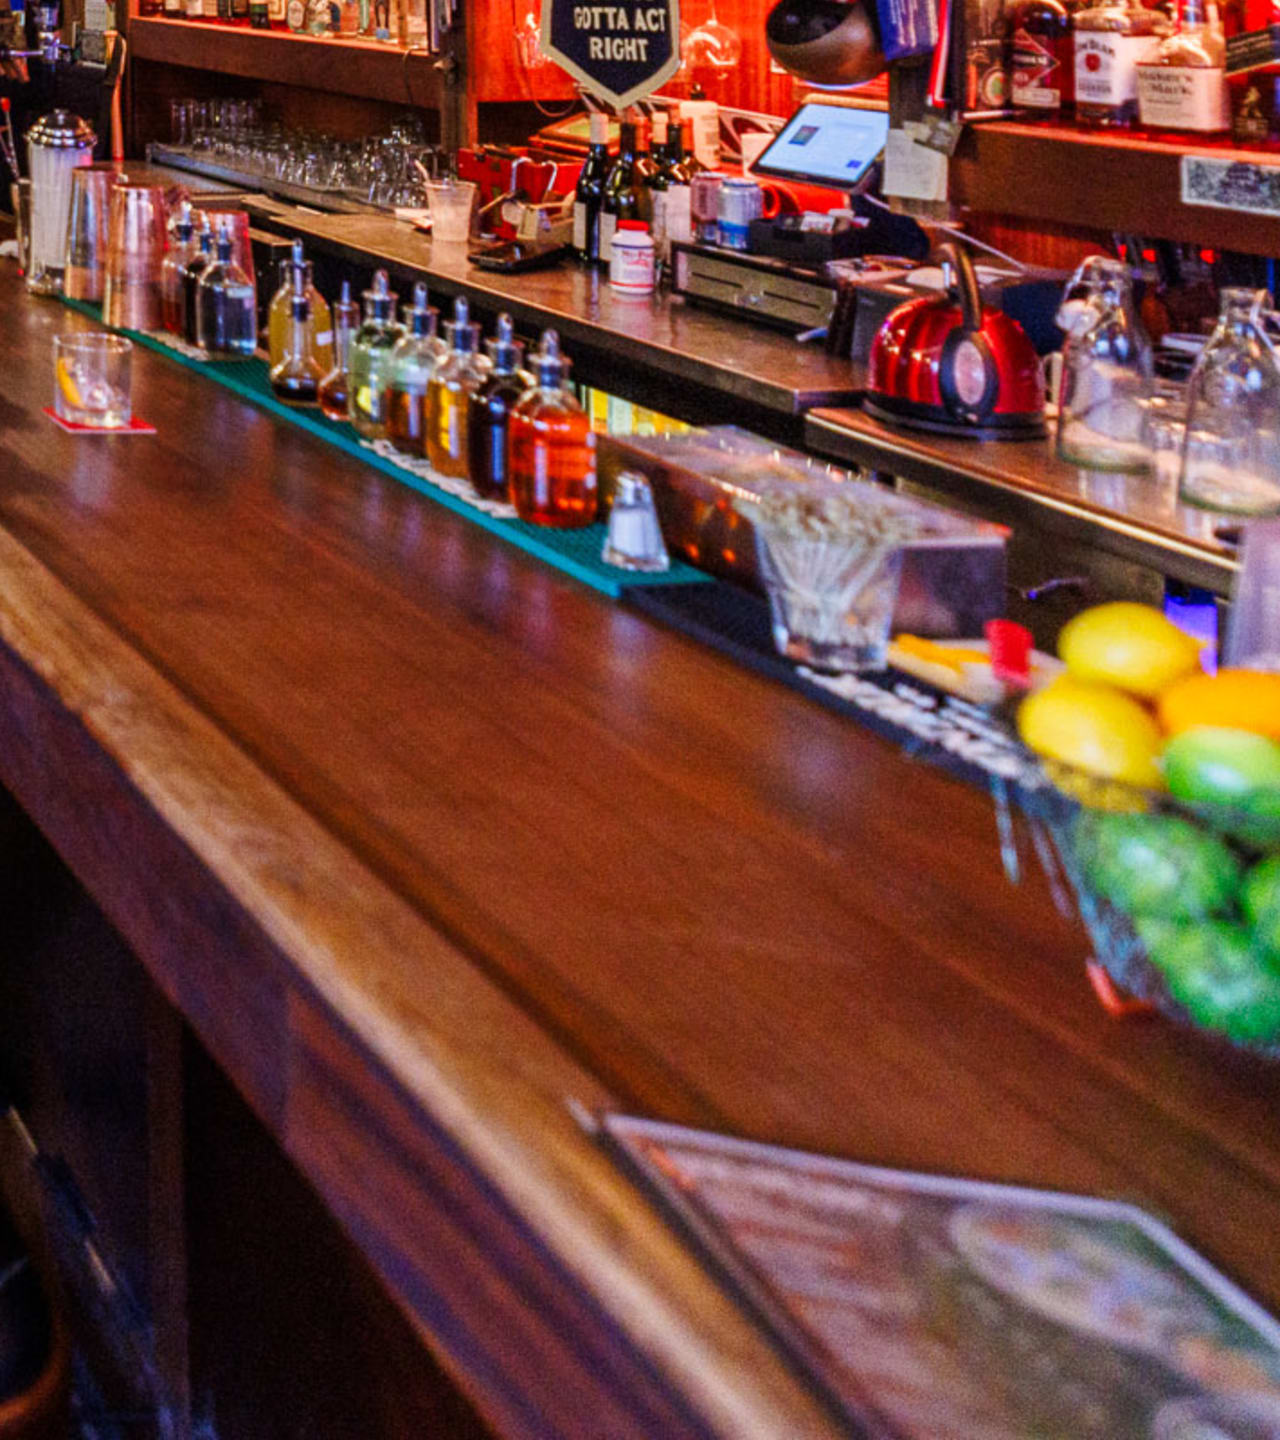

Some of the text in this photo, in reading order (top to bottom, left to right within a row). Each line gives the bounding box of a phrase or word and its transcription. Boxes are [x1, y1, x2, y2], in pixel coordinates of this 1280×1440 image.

[573, 6, 667, 32] GOTTA ACT
[589, 36, 650, 63] RIGHT
